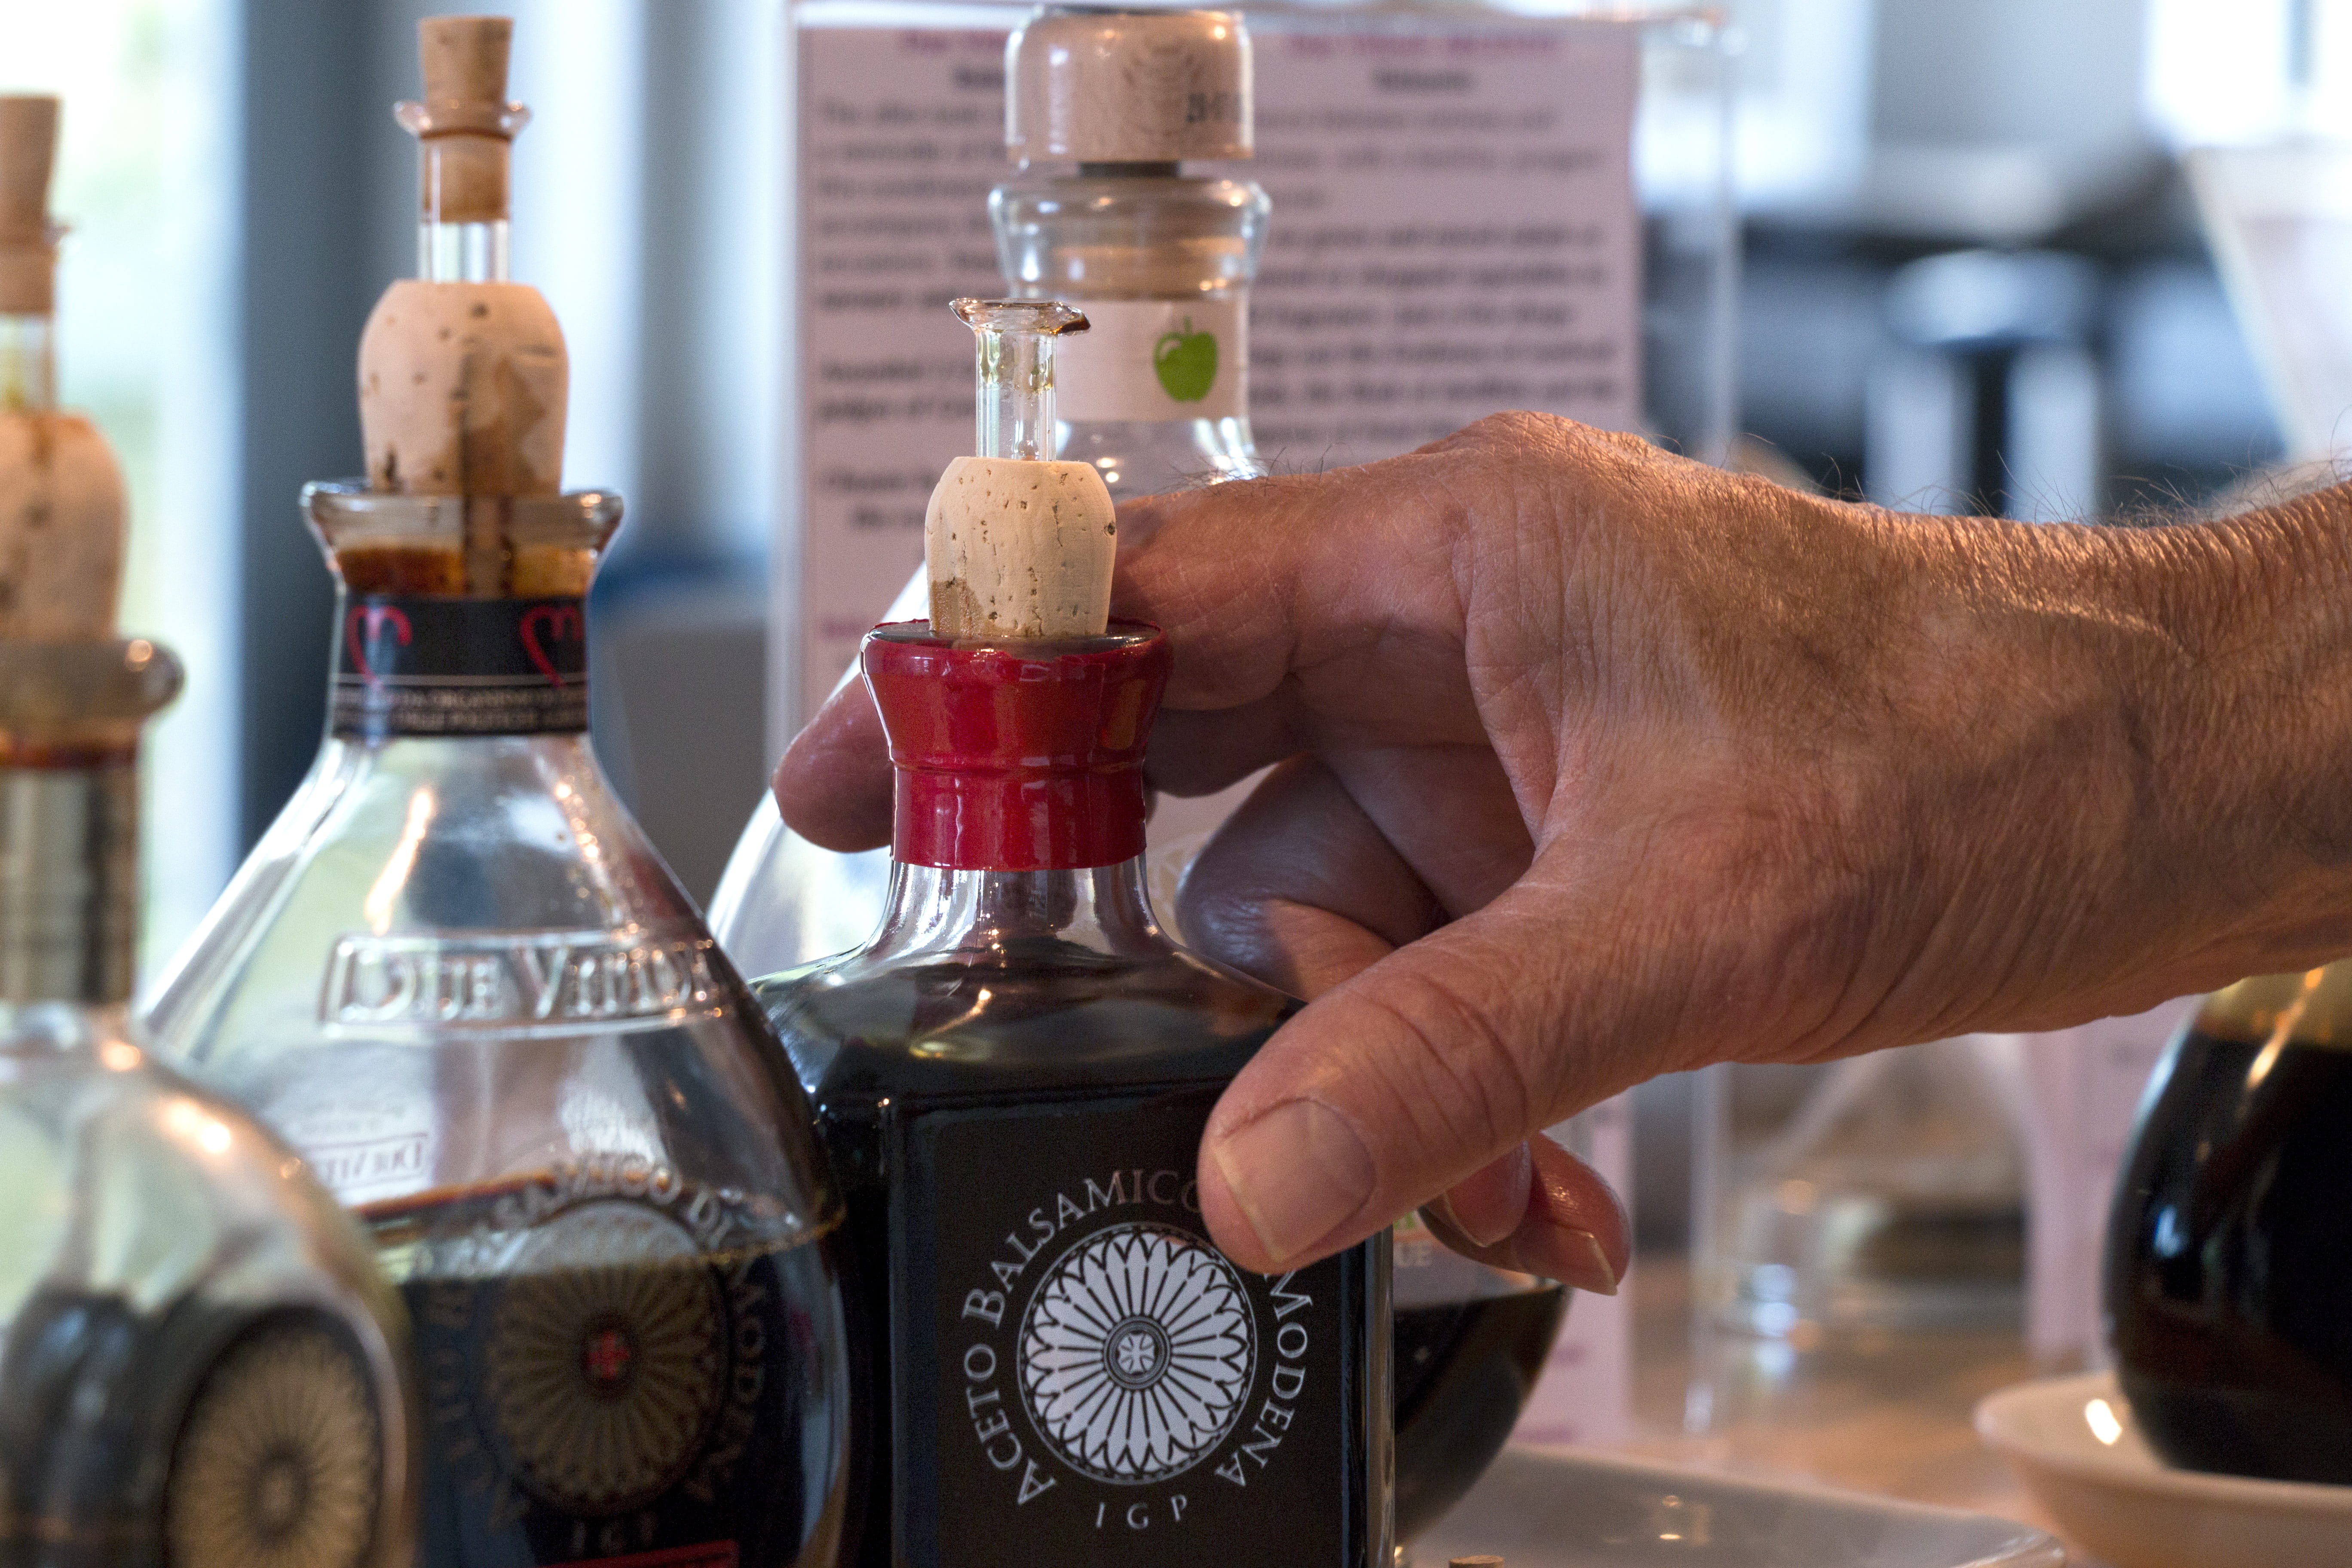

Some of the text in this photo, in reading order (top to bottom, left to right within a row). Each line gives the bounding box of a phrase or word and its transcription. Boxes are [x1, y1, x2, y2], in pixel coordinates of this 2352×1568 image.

[963, 1343, 1057, 1506] ACETO
[1215, 1271, 1313, 1487] MODENA
[1096, 1494, 1188, 1530] IGP
